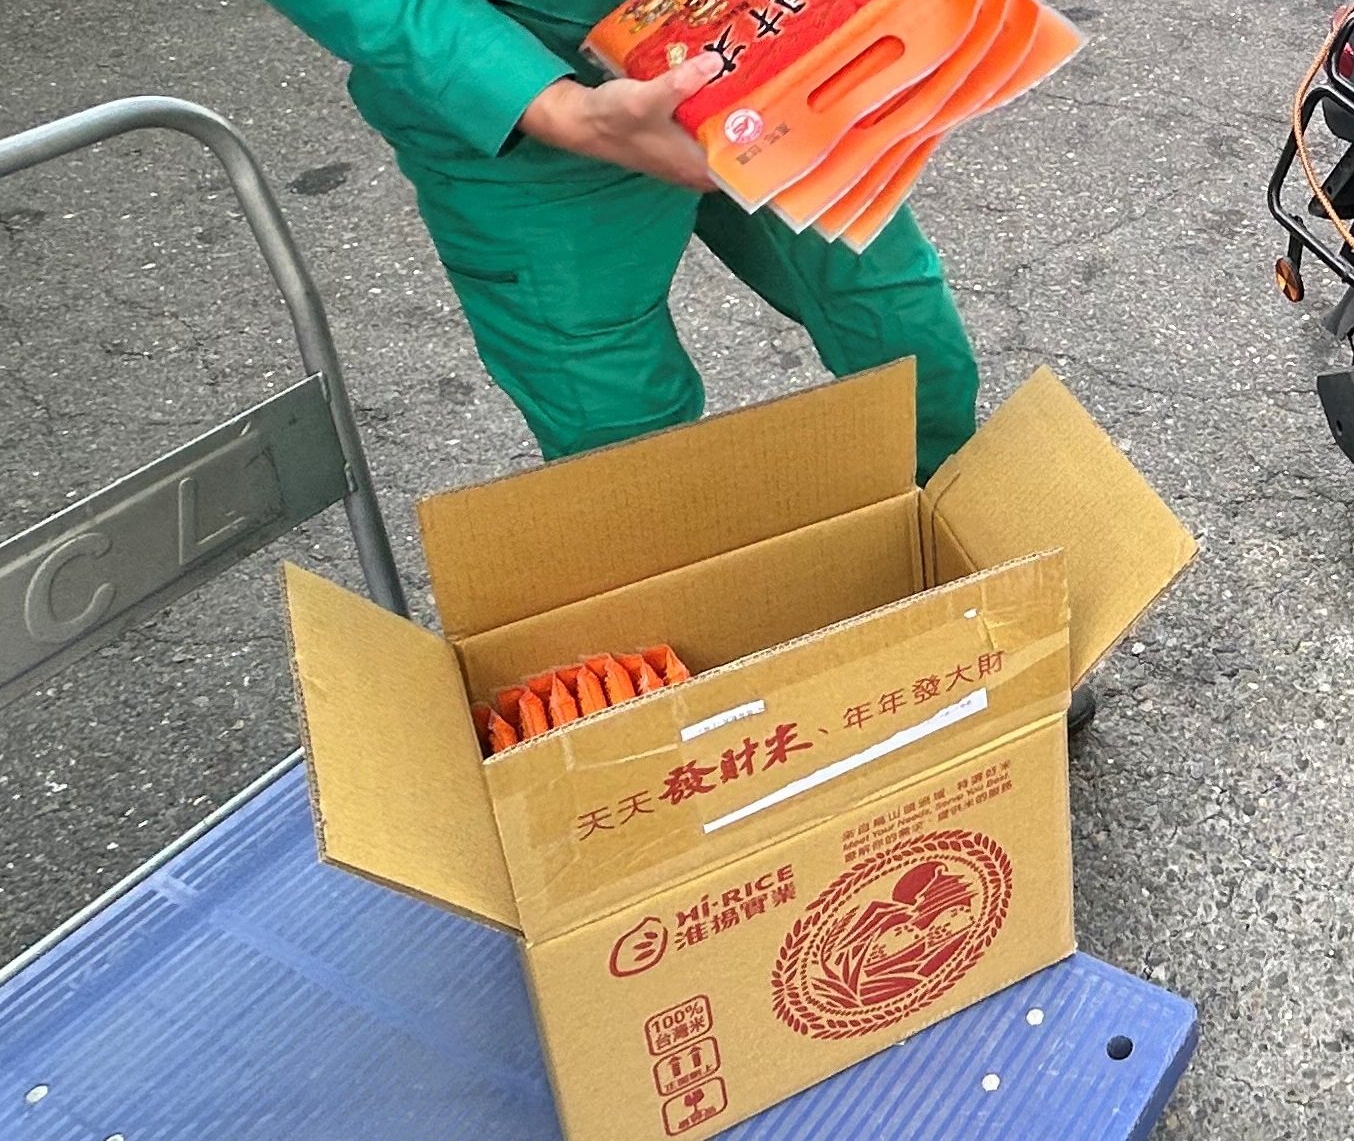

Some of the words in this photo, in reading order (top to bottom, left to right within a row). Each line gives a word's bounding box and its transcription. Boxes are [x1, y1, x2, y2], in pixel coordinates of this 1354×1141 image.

[650, 1001, 704, 1034] 100%
[655, 1015, 706, 1051] 台灣米
